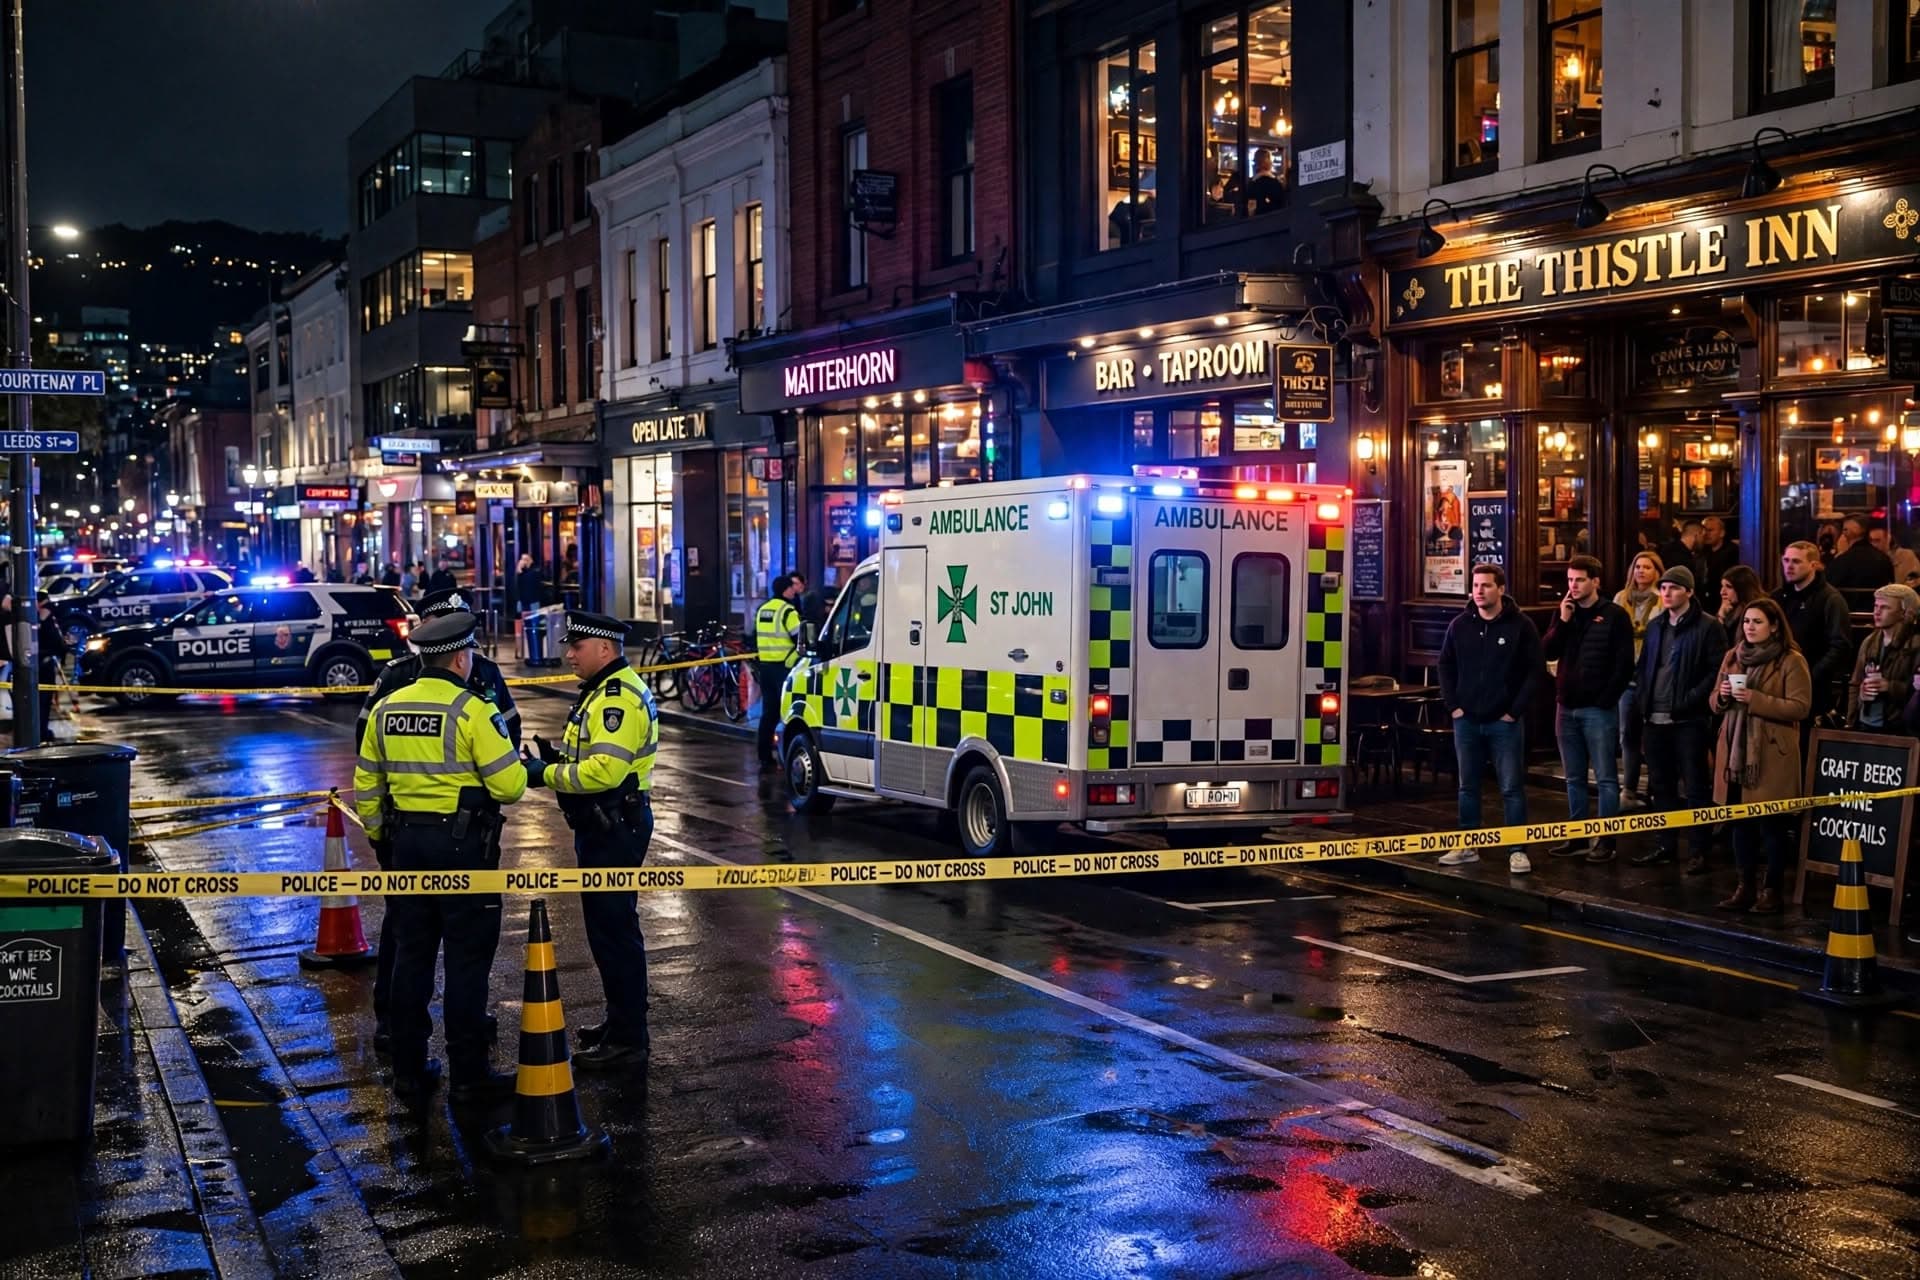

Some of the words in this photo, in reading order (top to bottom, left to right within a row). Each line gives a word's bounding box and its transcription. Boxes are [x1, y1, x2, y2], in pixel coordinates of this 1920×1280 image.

[1445, 258, 1523, 310] THE
[1536, 224, 1727, 297] THISTLE
[1745, 204, 1842, 268] INN
[785, 348, 895, 398] MATTERHORN
[1096, 358, 1136, 391] BAR
[1159, 339, 1266, 384] TAPROOM
[83, 375, 100, 391] PL
[632, 420, 658, 444] OPEN
[659, 415, 686, 441] LATE
[3, 434, 42, 449] LEEDS
[46, 436, 59, 448] ST
[929, 505, 1029, 535] AMBULANCE
[1154, 506, 1289, 532] AMBULANCE
[101, 605, 151, 618] POLICE
[990, 591, 1009, 616] ST
[1012, 591, 1053, 616] JOHN
[178, 638, 251, 657] POLICE
[386, 715, 439, 734] POLICE
[1820, 757, 1859, 781] CRAFT
[1862, 763, 1903, 787] BEERS
[1693, 807, 1733, 823] POLICE
[1747, 804, 1762, 816] DO
[1526, 824, 1567, 841] POLICE
[1584, 821, 1600, 834] DO
[1603, 818, 1627, 833] NOT
[1629, 814, 1668, 831] CROSS
[1421, 836, 1437, 849] DO
[1438, 834, 1462, 848] NOT
[1464, 830, 1501, 847] CROSS
[1013, 859, 1057, 875] POLICE
[1074, 858, 1091, 872] DO
[1093, 857, 1117, 871] NOT
[1120, 854, 1160, 870] CROSS
[1183, 850, 1224, 866] POLICE
[1239, 849, 1256, 864] DO
[506, 873, 559, 890] POLICE
[581, 872, 602, 887] DO
[605, 871, 635, 887] NOT
[637, 870, 685, 886] CROSS
[830, 866, 878, 882] POLICE
[895, 865, 913, 880] DO
[916, 863, 942, 879] NOT
[944, 862, 986, 878] CROSS
[27, 877, 91, 895] POLICE
[117, 877, 142, 894] DO
[146, 877, 181, 894] NOT
[184, 876, 239, 893] CROSS
[281, 875, 338, 893] POLICE
[360, 875, 383, 891] DO
[385, 874, 418, 891] NOT
[420, 874, 471, 891] CROSS
[8, 966, 38, 981] WINE
